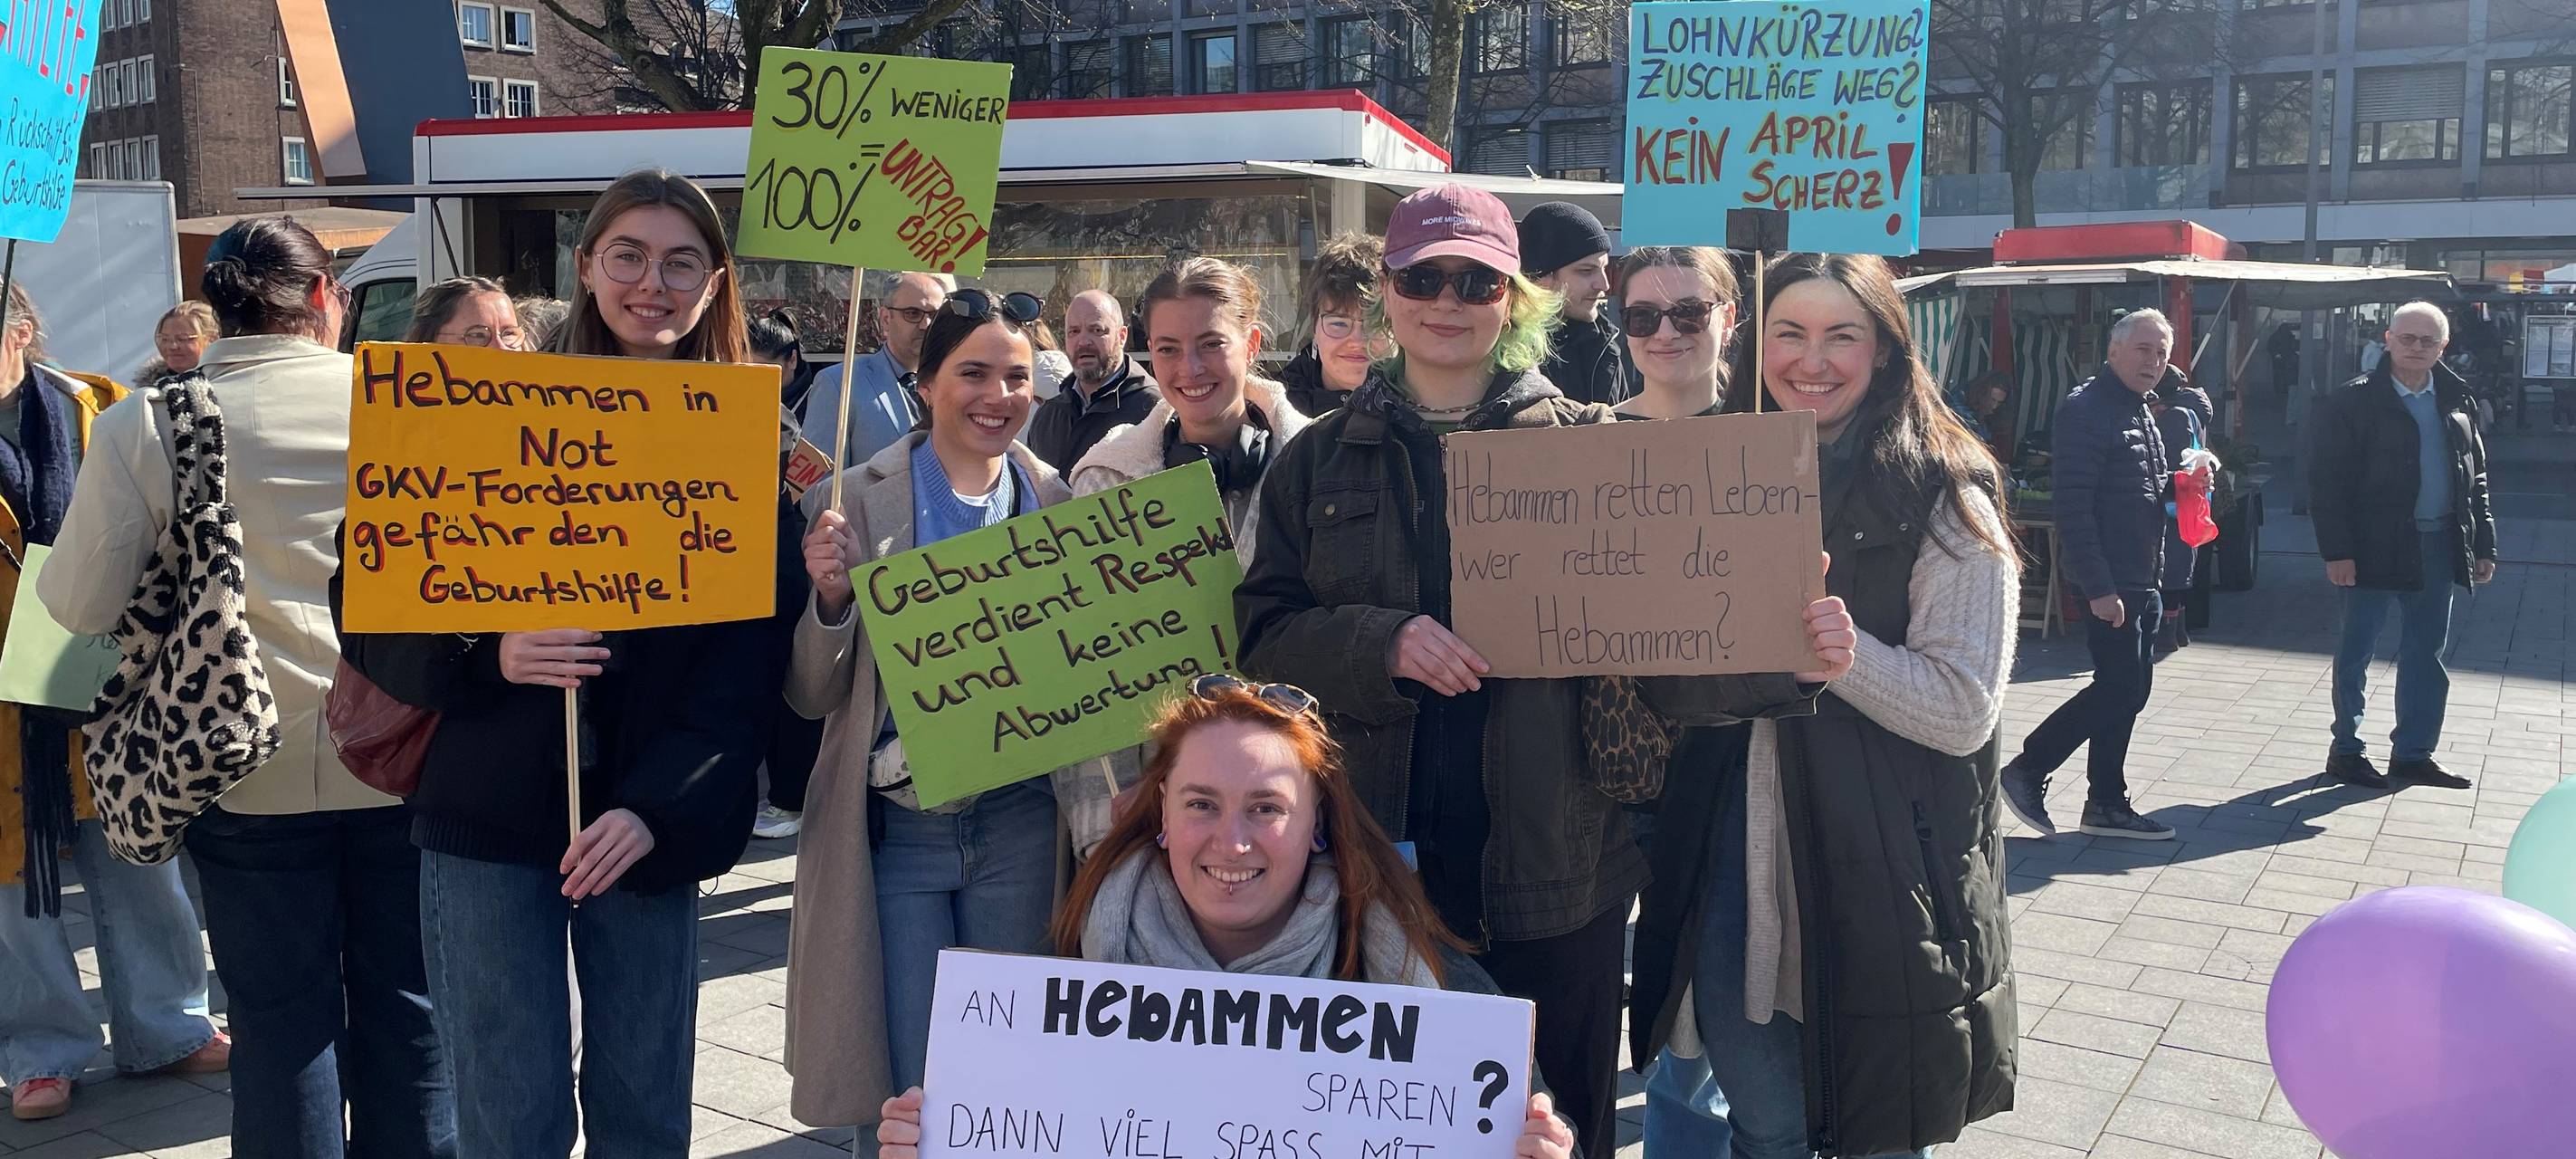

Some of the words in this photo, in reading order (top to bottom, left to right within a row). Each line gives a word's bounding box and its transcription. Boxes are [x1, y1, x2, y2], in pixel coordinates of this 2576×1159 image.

[1643, 5, 1923, 60] LOHNKÜRZUNG?
[772, 61, 886, 139] 30%
[1636, 59, 1823, 102] ZUSCHLÄGE
[1833, 61, 1920, 123] WEG?
[749, 158, 876, 244] 100%
[1421, 216, 1444, 226] MORE
[362, 349, 650, 413] Hebammen
[683, 383, 719, 413] in
[520, 426, 618, 469] Not
[356, 462, 739, 519] GKV-Forderungen
[1452, 450, 1579, 526] Hebammen
[1594, 448, 1693, 520] retten
[680, 511, 737, 554] die
[868, 488, 1176, 616] Geburtshilfe
[1561, 527, 1646, 577] rettet
[1683, 526, 1732, 580] die
[419, 554, 690, 615] Geburtshilfe!
[892, 572, 1093, 667] verdient
[1091, 516, 1236, 594] Respekt
[1535, 591, 1735, 668] Hebammen?
[911, 647, 1021, 713] und
[1057, 609, 1188, 667] keine
[960, 989, 1016, 1030] AN
[949, 1103, 1064, 1153] DANN
[1213, 1121, 1322, 1159] SPASS
